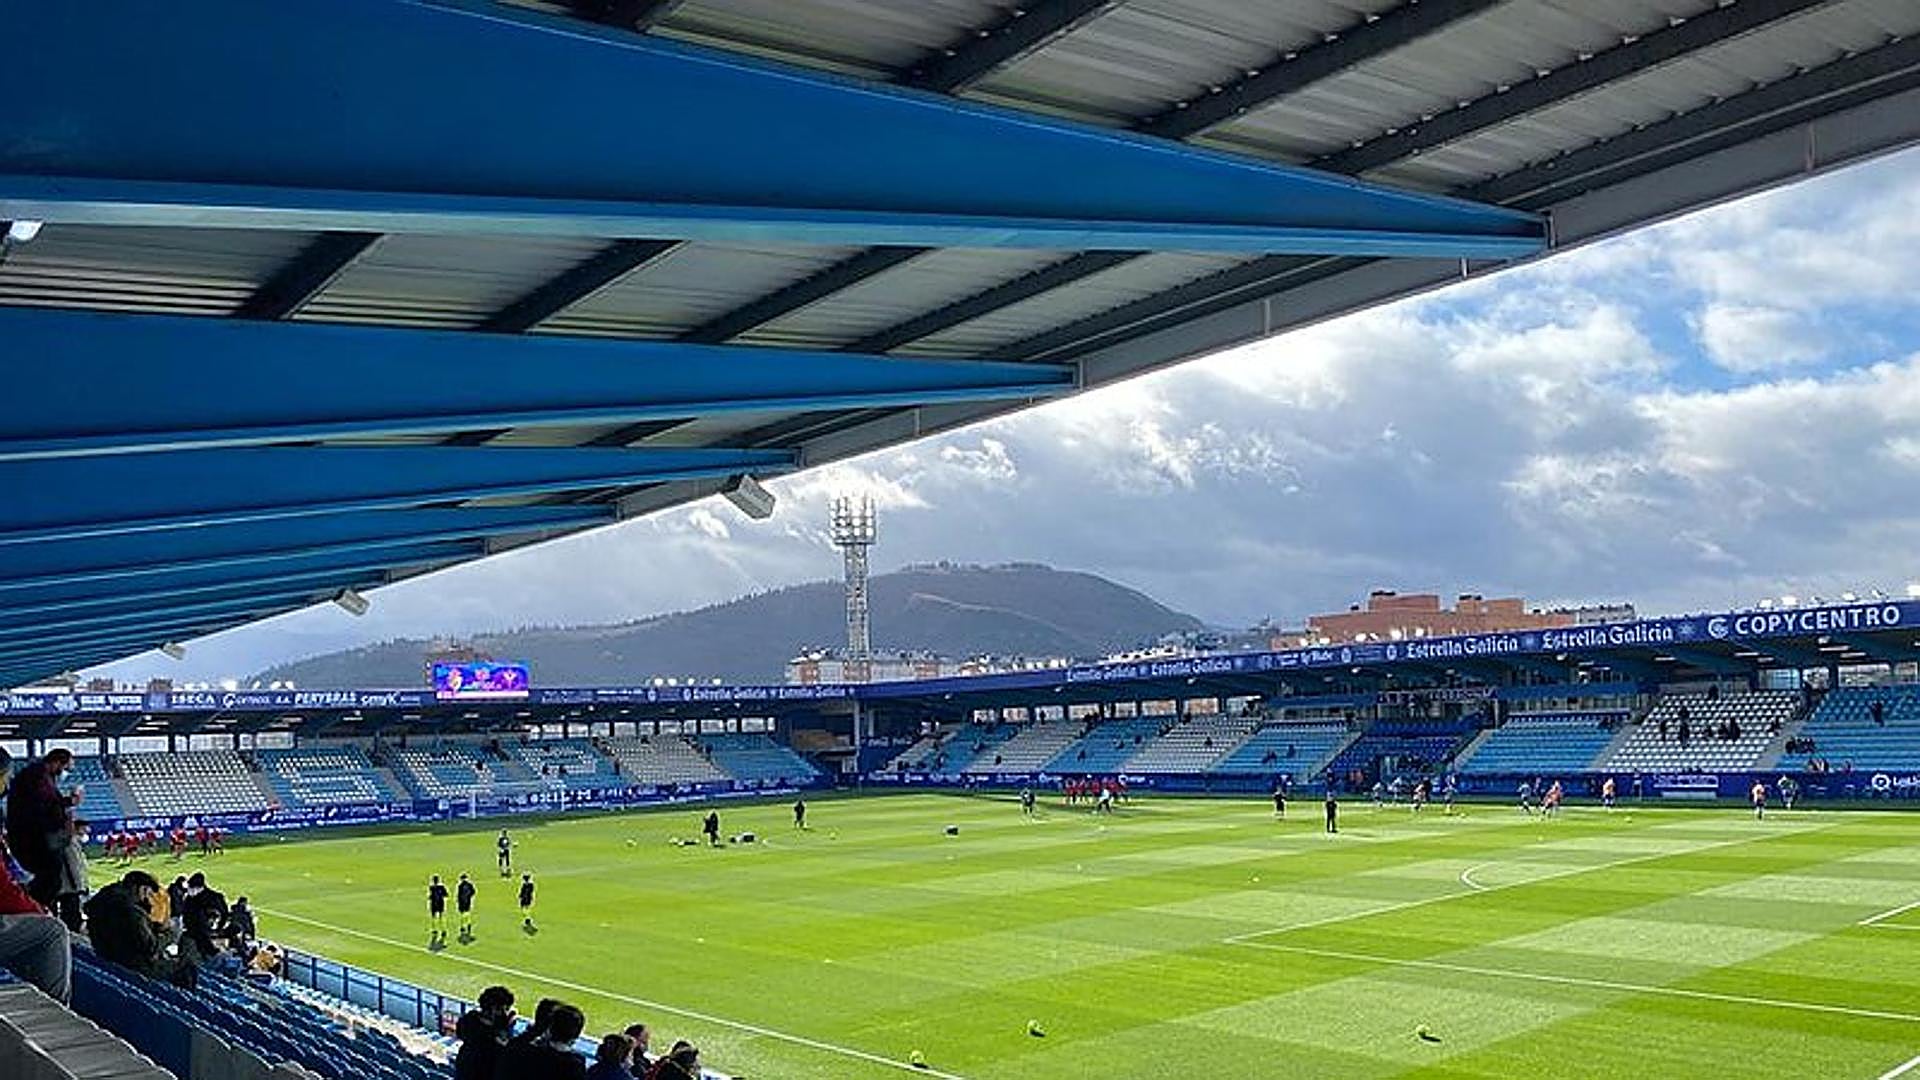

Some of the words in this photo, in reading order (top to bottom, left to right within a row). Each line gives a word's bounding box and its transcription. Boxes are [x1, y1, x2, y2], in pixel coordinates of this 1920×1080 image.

[1735, 605, 1900, 635] COPYCENTRO
[1407, 640, 1462, 659] Estrella
[1463, 637, 1518, 655] Galicia
[1542, 627, 1606, 649] Estrella
[1608, 623, 1673, 645] Galicia
